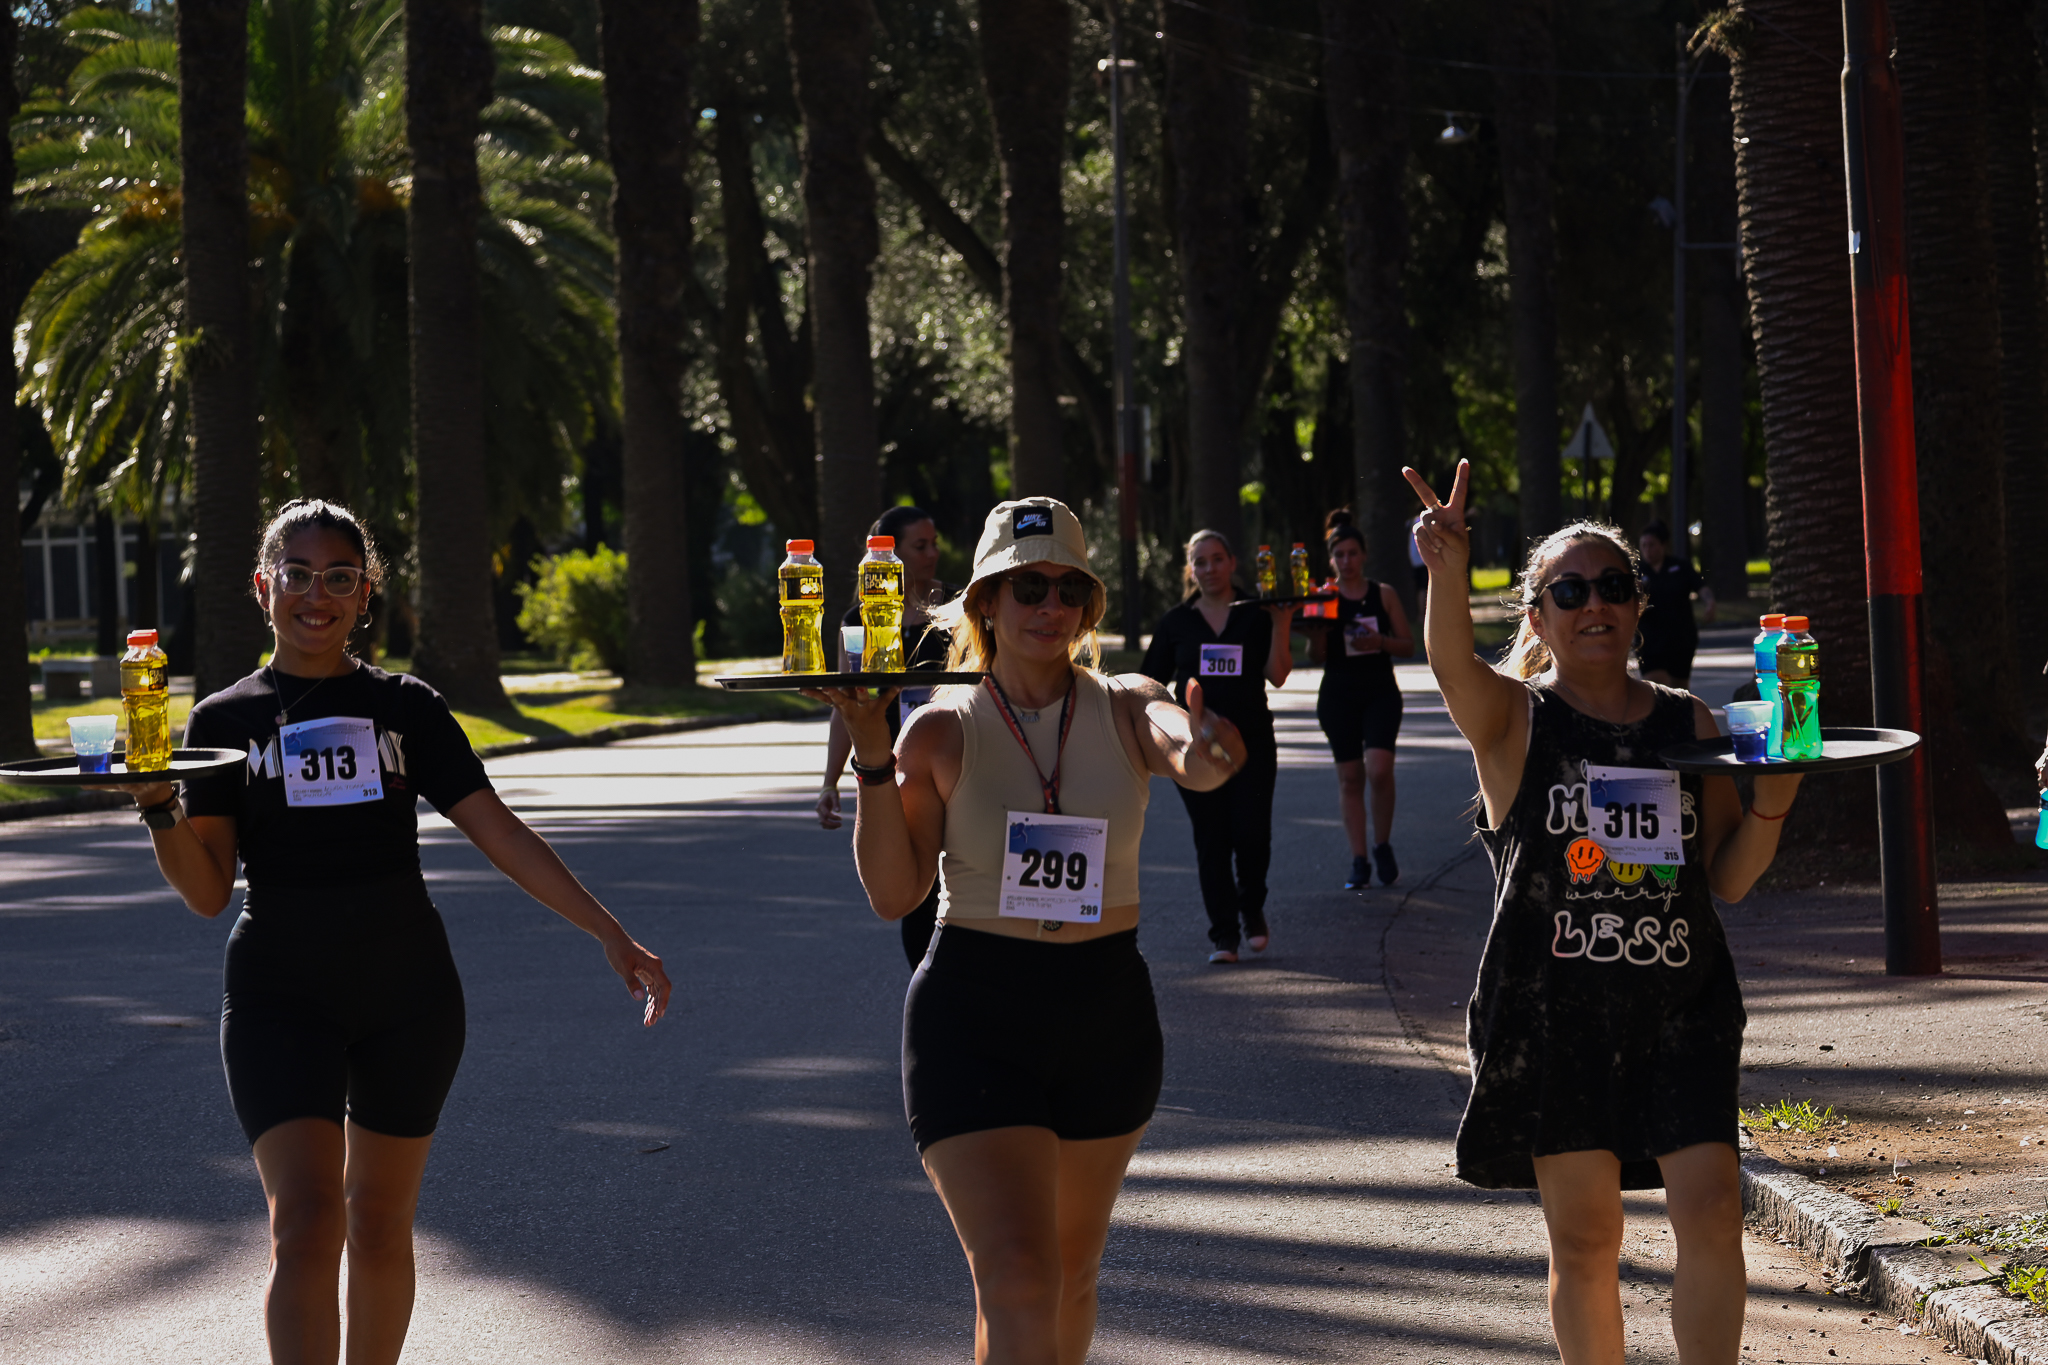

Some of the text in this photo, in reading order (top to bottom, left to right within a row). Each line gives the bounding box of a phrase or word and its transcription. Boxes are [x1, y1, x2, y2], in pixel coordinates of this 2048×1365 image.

[1022, 513, 1043, 522] NIKE
[1207, 658, 1236, 673] 300
[300, 745, 357, 781] 313
[363, 788, 378, 797] 313
[1603, 801, 1659, 839] 315
[1664, 851, 1679, 861] 315
[1019, 848, 1087, 891] 299
[1566, 887, 1681, 912] worry
[1080, 904, 1098, 916] 299
[1552, 910, 1690, 967] LESS
